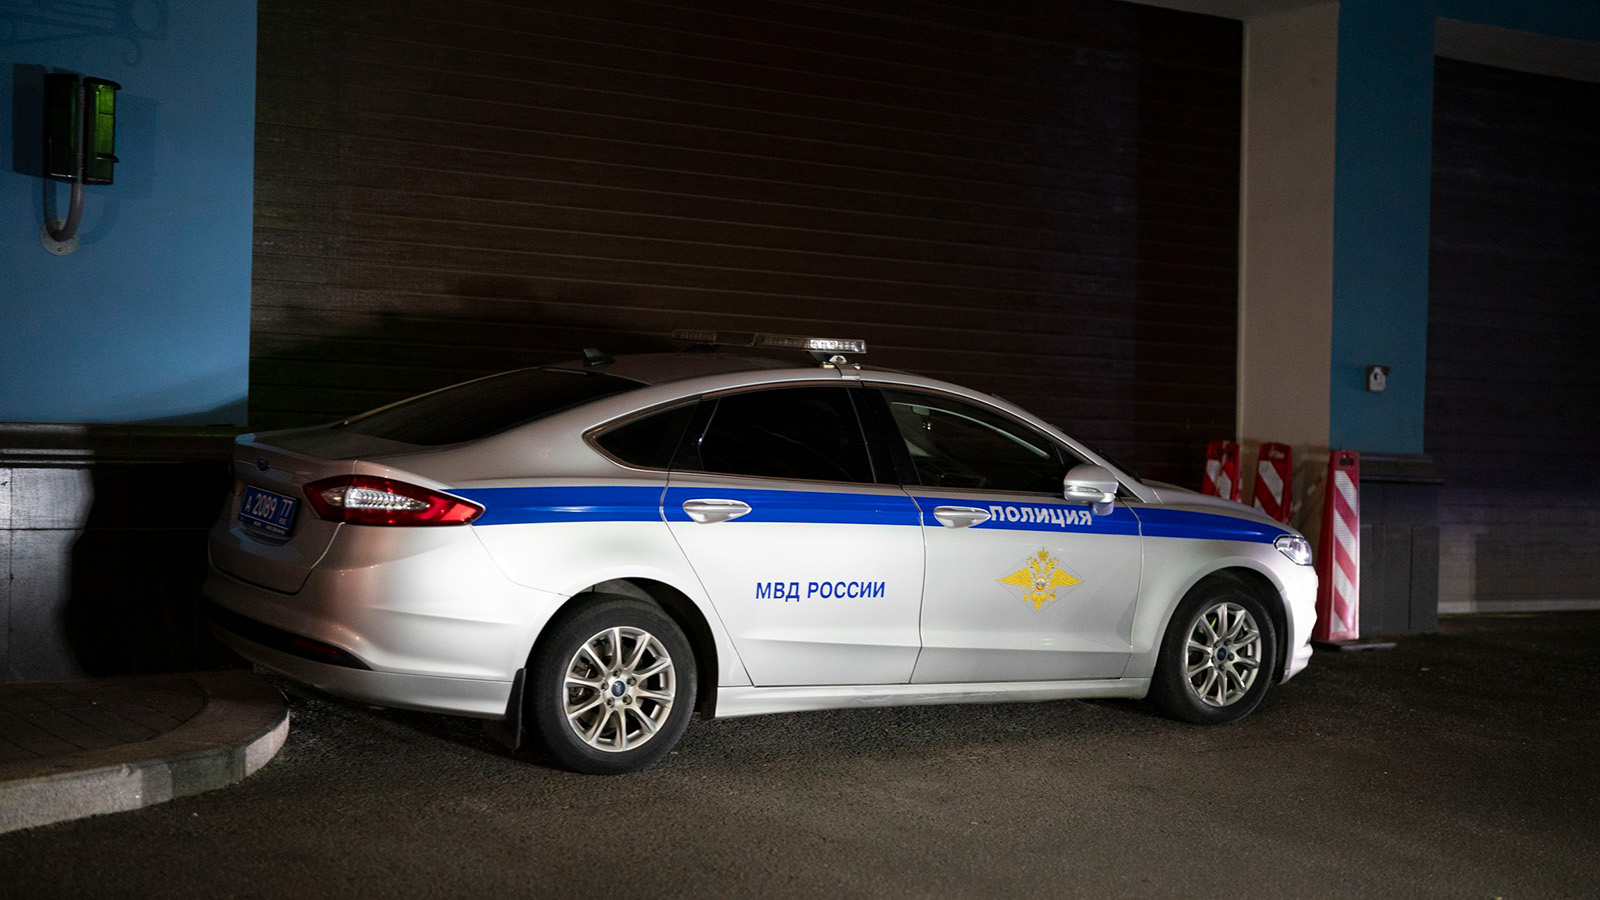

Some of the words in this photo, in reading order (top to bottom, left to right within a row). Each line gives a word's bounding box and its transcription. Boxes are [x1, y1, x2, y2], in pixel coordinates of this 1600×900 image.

[252, 493, 277, 519] 2089
[280, 499, 293, 517] 77
[989, 505, 1092, 527] ПОЛИЦИЯ
[755, 582, 800, 602] МВД
[807, 581, 885, 599] РОССИИ
